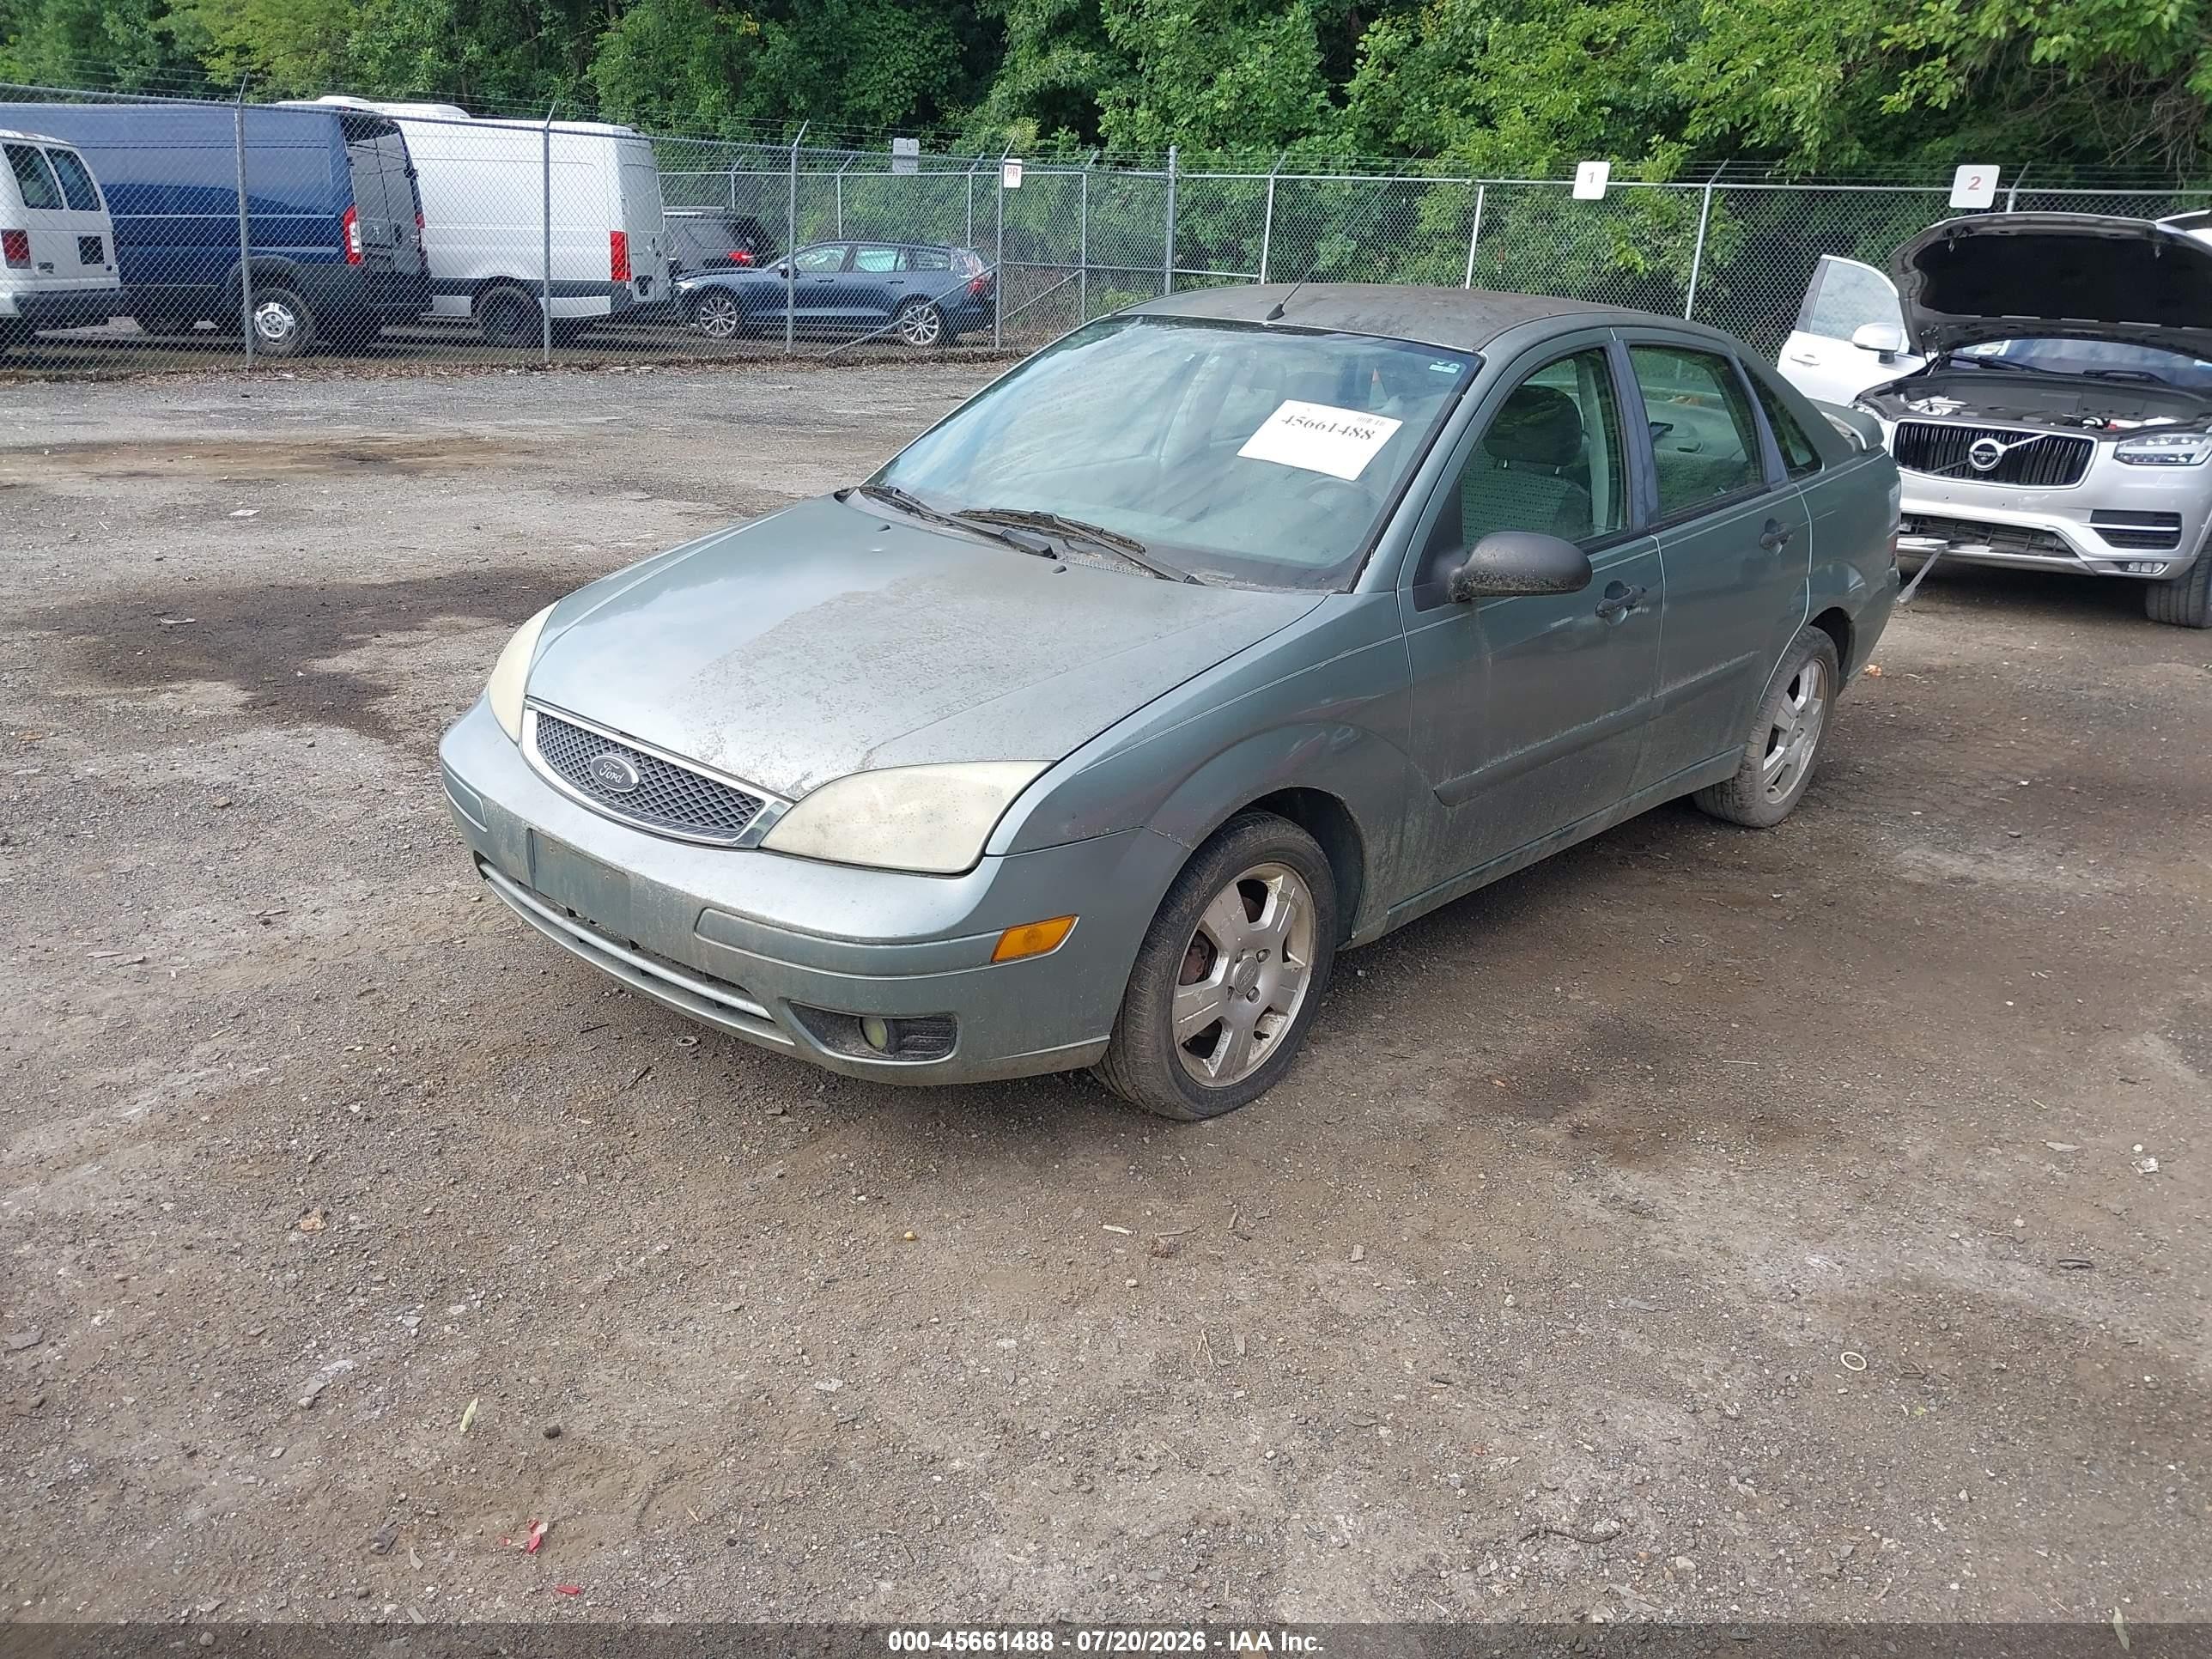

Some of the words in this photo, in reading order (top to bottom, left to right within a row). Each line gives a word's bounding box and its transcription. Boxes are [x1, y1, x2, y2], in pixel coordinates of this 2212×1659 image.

[1588, 171, 1595, 184] 1
[1967, 175, 1982, 190] 2
[1281, 415, 1376, 441] 45661488
[599, 761, 626, 784] Ford
